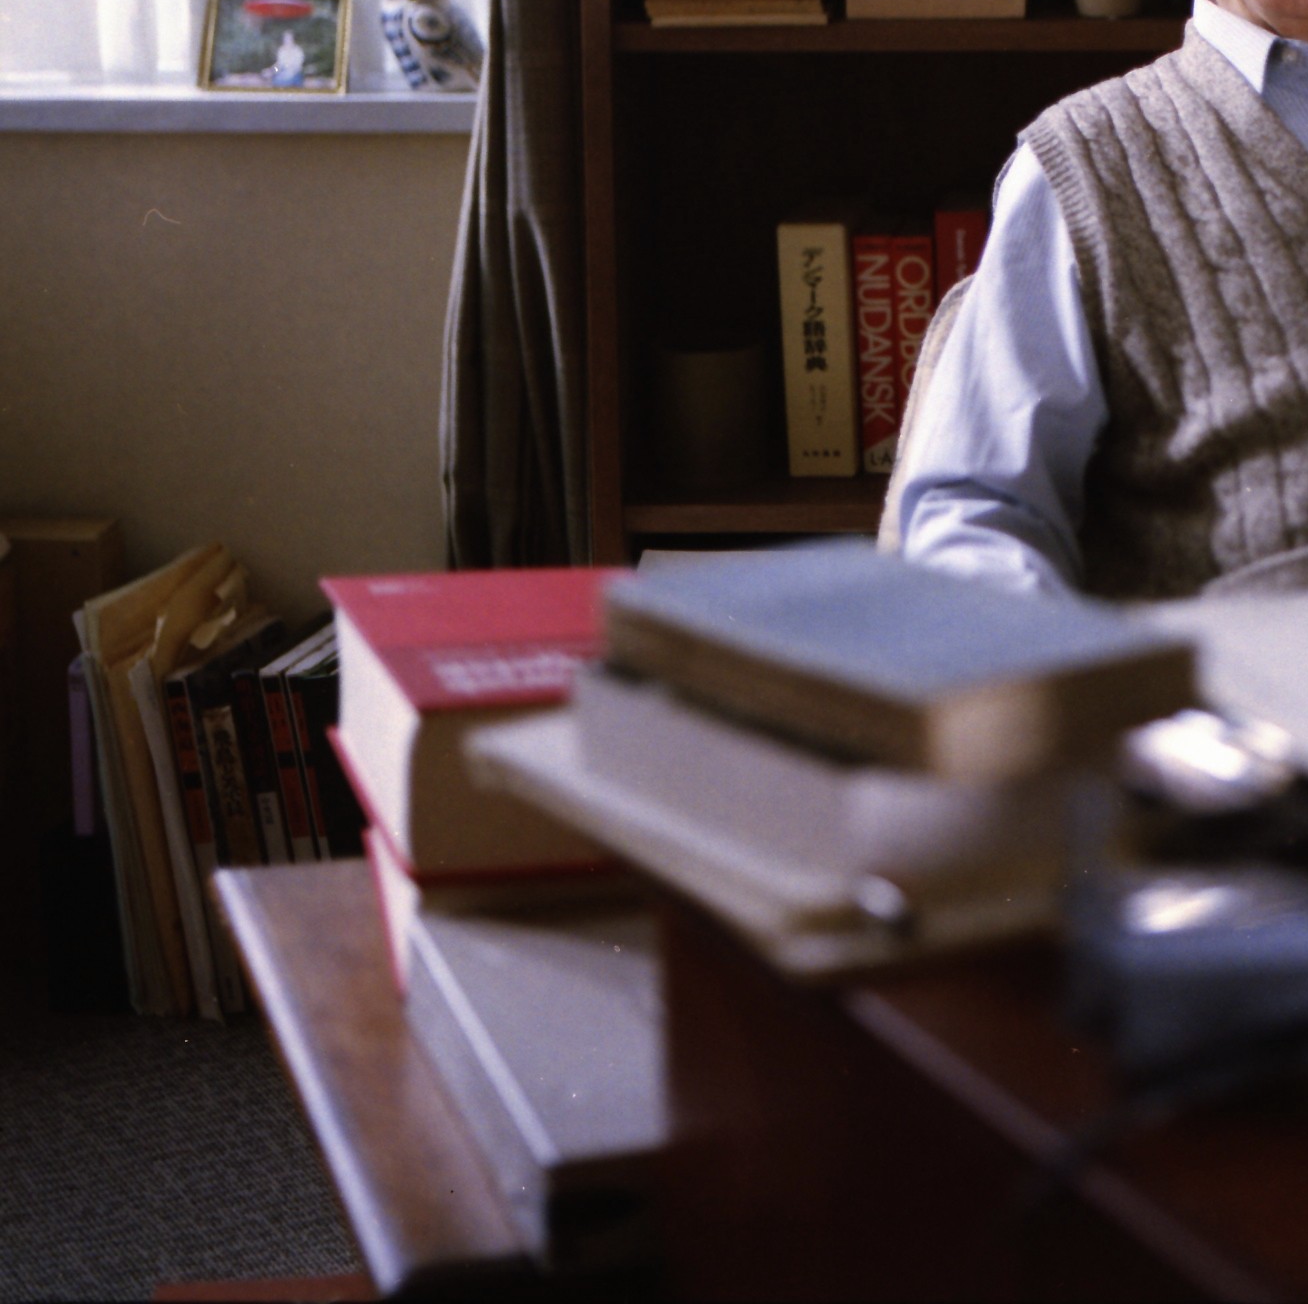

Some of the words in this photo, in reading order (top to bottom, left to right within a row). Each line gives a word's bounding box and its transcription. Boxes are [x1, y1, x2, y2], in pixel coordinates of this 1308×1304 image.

[801, 248, 828, 373] デンマーク語辞典
[855, 253, 896, 426] NUDANSK
